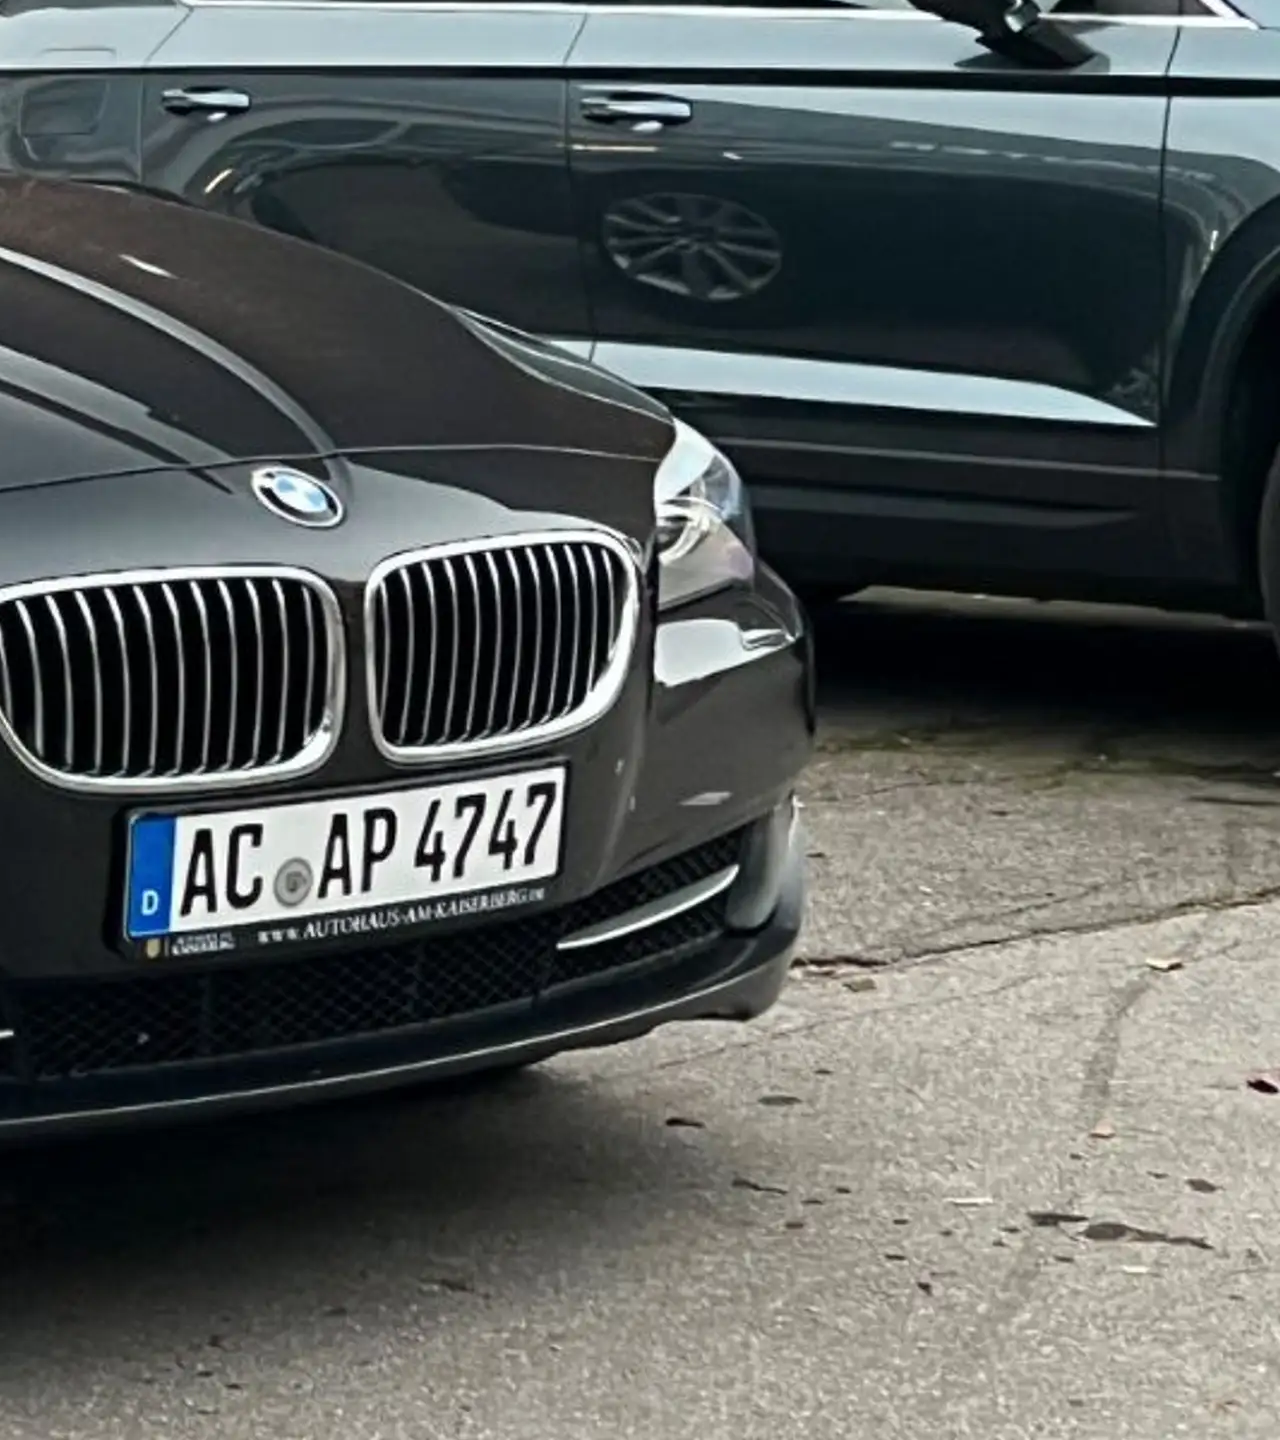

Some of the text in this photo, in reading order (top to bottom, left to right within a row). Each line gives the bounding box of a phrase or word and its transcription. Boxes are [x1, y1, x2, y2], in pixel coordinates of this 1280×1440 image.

[180, 781, 557, 917] AC AP 4747
[141, 888, 160, 917] D
